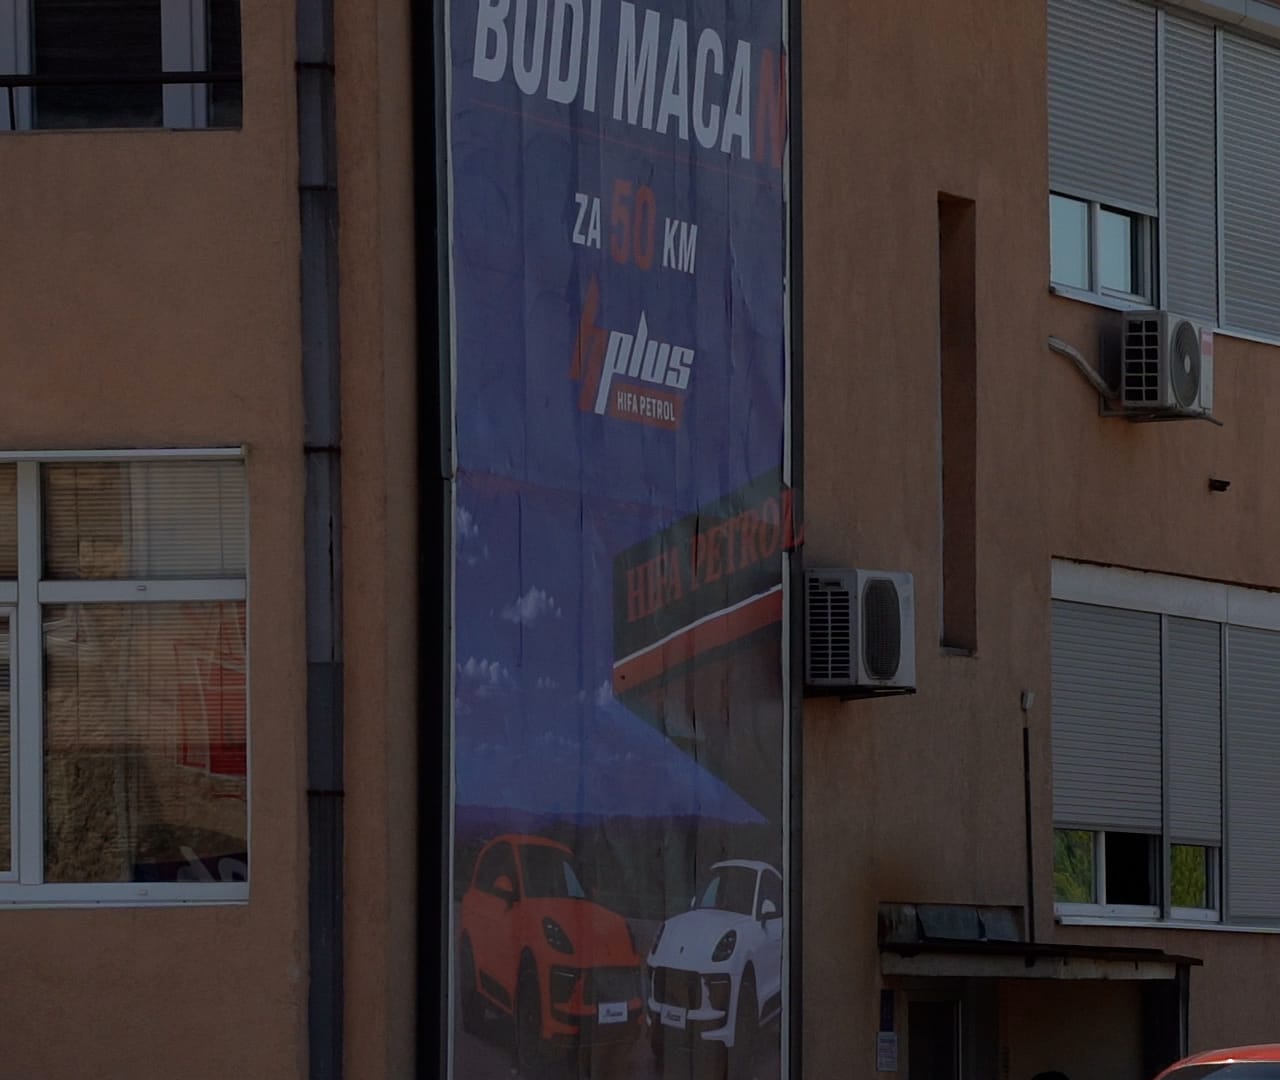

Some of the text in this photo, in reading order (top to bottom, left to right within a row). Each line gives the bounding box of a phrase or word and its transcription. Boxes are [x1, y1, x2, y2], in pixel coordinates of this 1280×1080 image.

[473, 0, 600, 112] BUDI
[572, 178, 698, 274] ZA 50 KM
[617, 391, 676, 421] HIFA PETROL
[626, 489, 804, 623] HIFA PETROL
